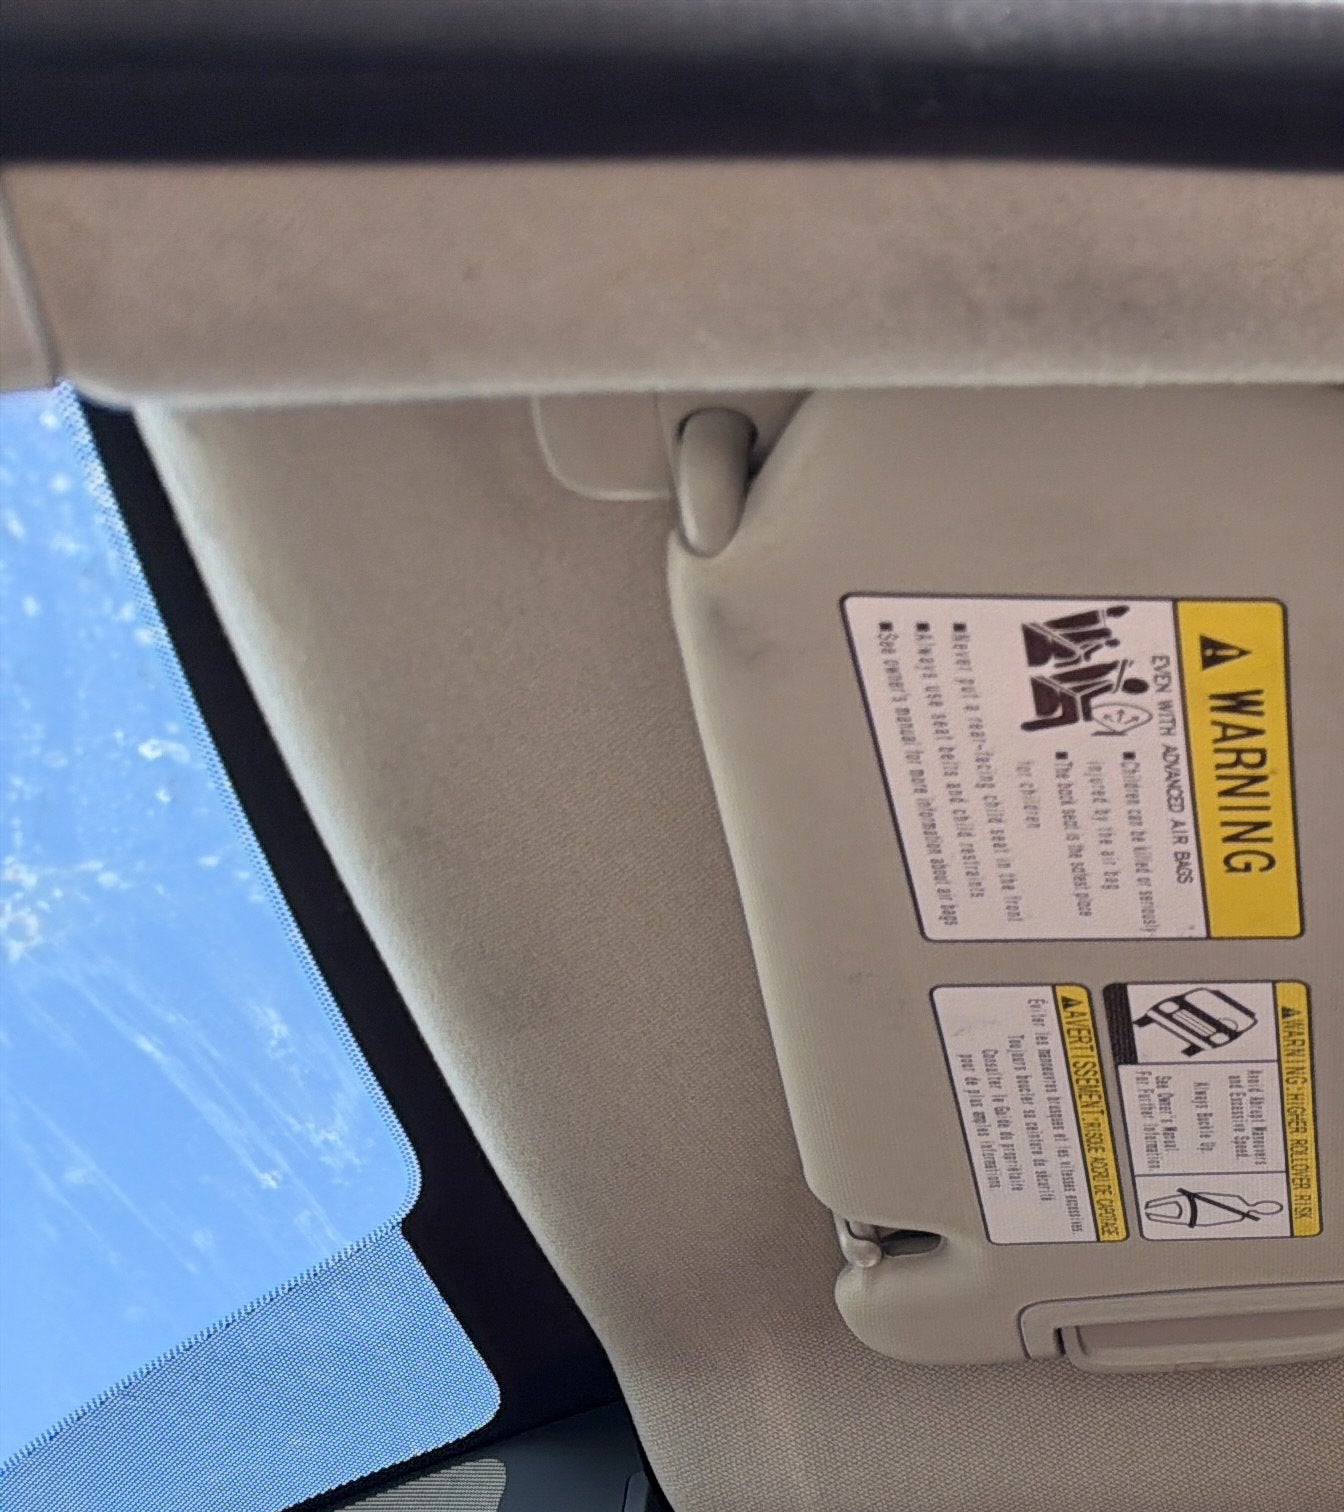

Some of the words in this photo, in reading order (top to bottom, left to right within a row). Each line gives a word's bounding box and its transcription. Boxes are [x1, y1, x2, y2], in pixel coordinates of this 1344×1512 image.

[1150, 655, 1172, 693] EVEN
[1157, 699, 1176, 735] WITH
[1161, 744, 1185, 812] ADVANCED
[1210, 688, 1274, 873] WARNING
[1170, 819, 1189, 844] AIR
[1173, 850, 1194, 884] BAGS
[1289, 1139, 1310, 1188] ROLLOVER
[1093, 1184, 1112, 1194] DE
[1293, 1194, 1312, 1219] RISK
